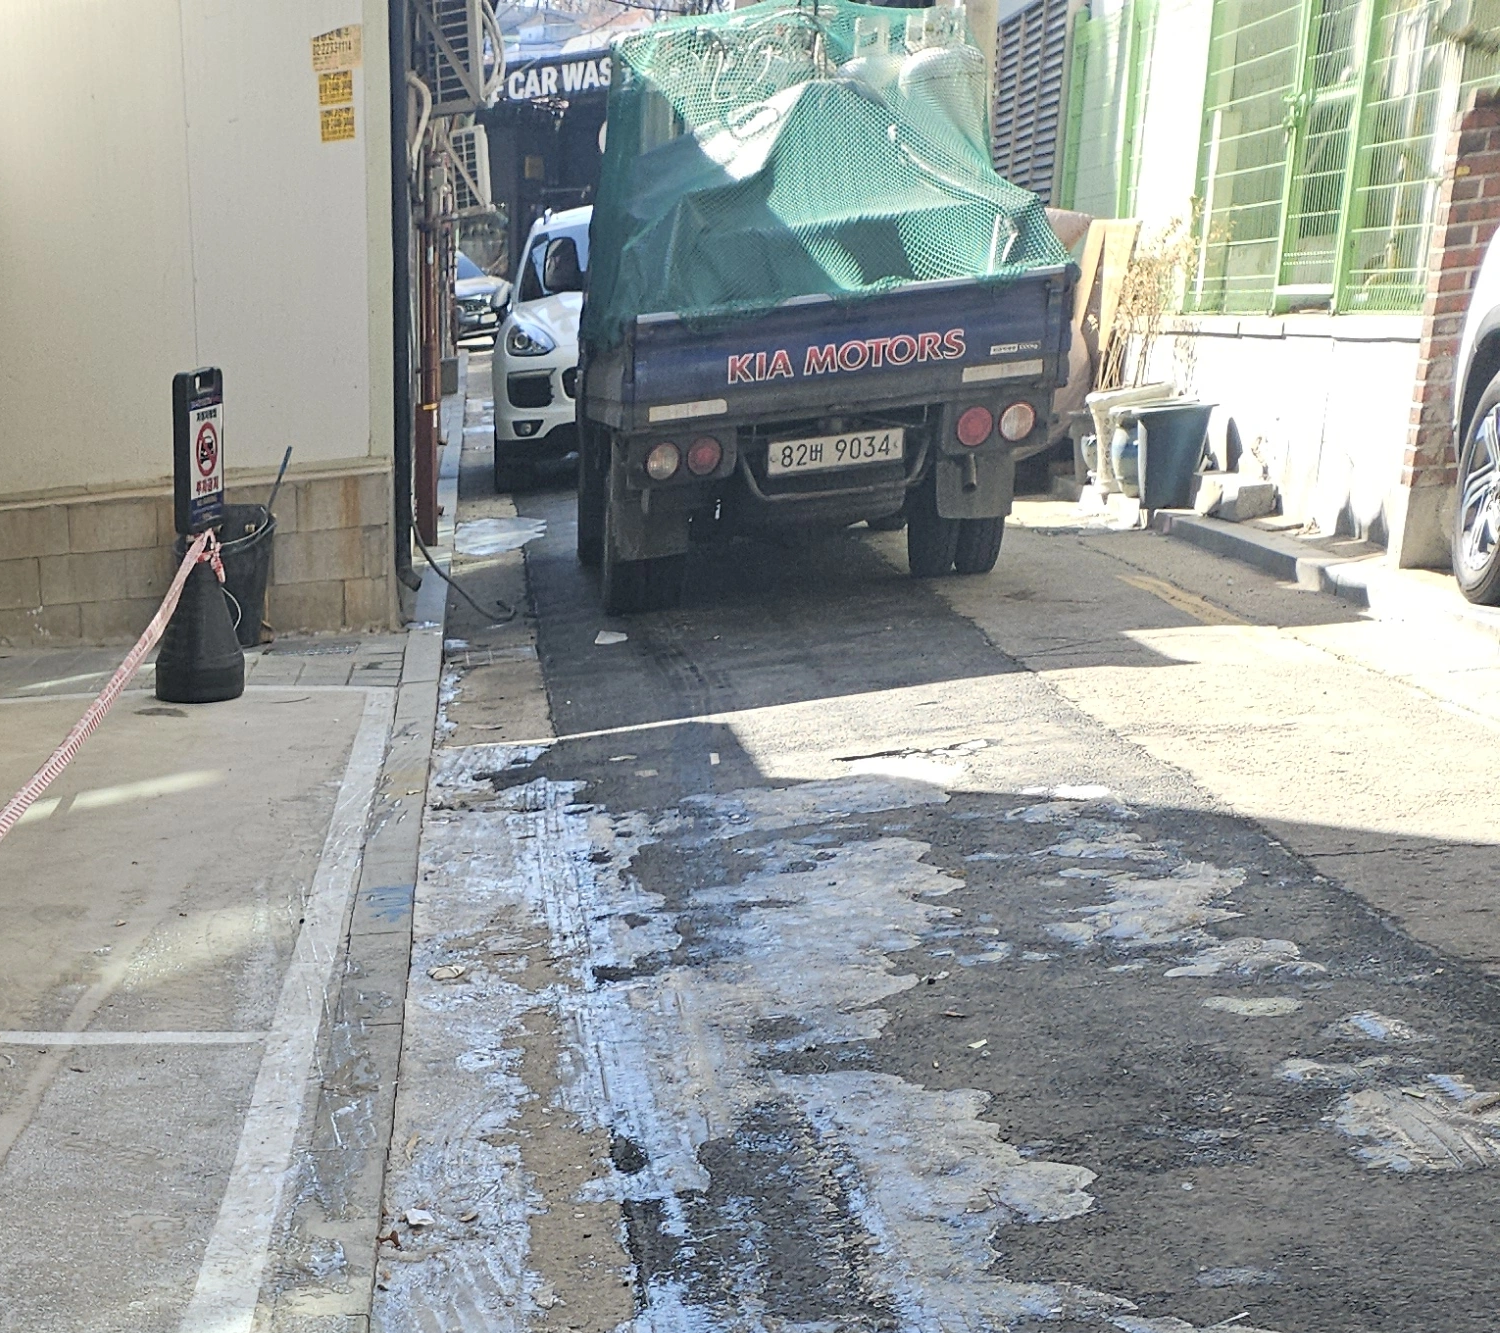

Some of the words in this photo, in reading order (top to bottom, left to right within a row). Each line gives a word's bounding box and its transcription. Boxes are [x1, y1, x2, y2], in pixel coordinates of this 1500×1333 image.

[508, 66, 558, 100] CAR
[562, 57, 614, 92] WAS
[728, 350, 794, 384] KIA
[804, 329, 966, 376] MOTORS
[835, 434, 891, 462] 9034
